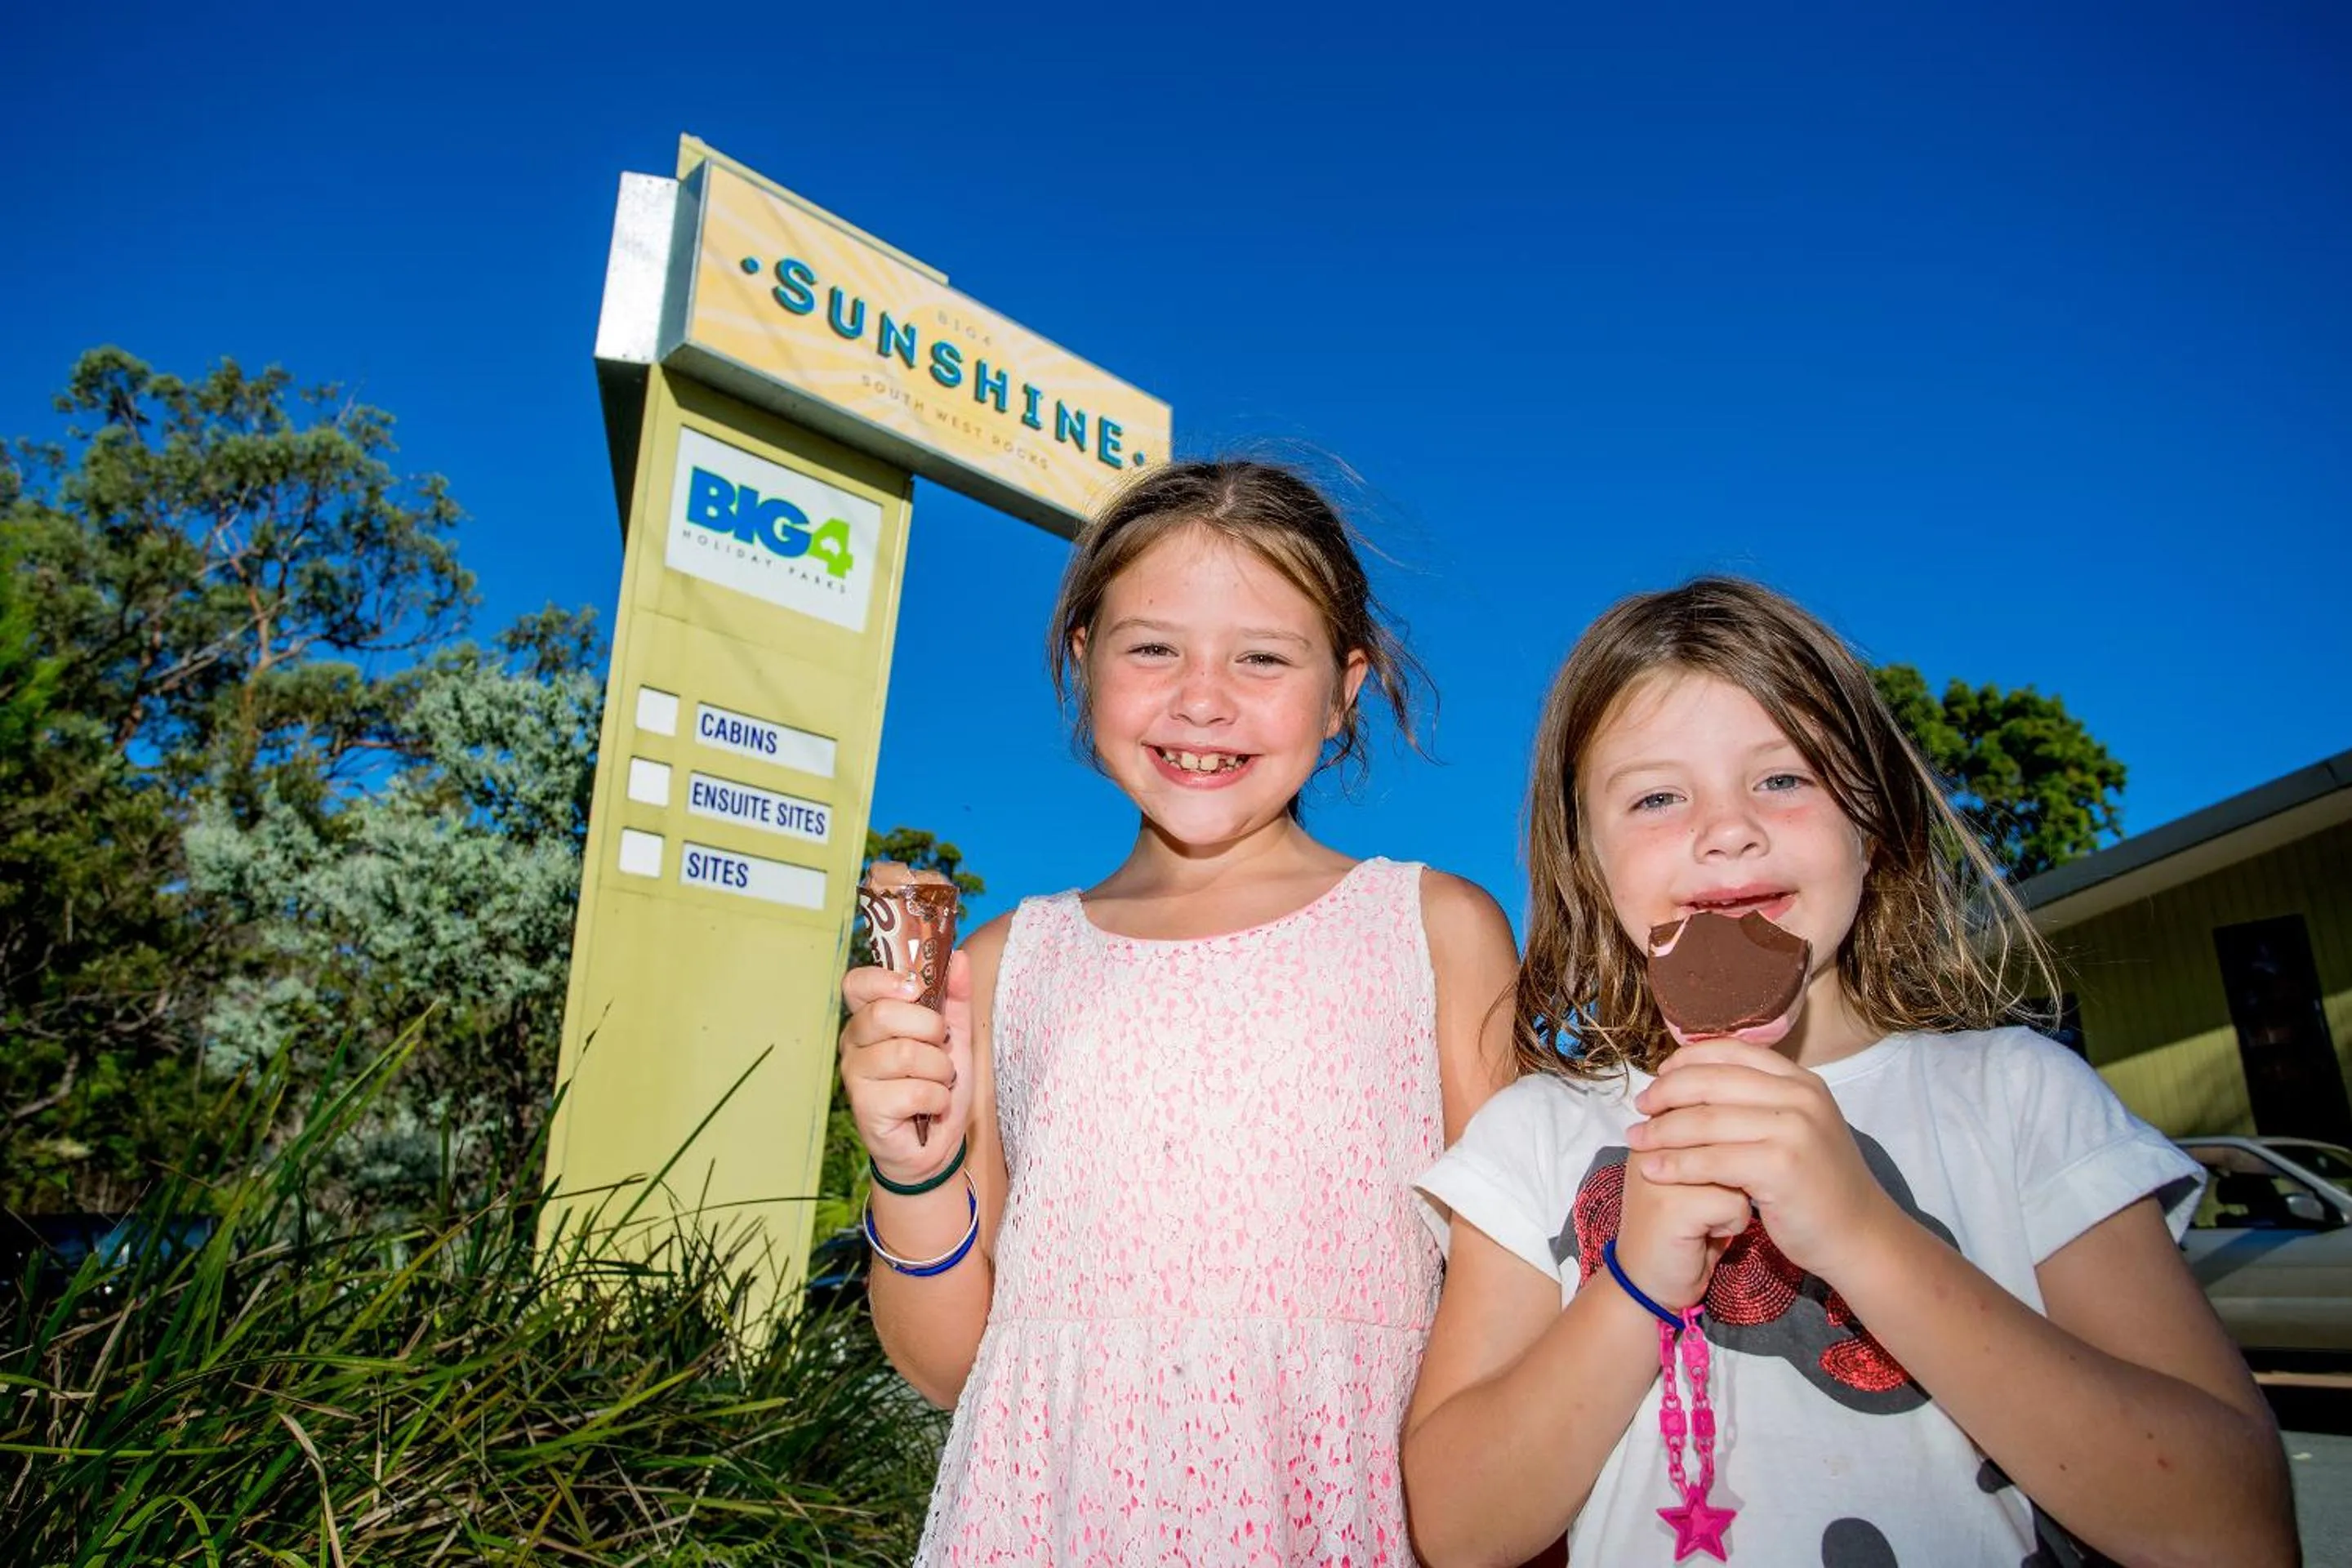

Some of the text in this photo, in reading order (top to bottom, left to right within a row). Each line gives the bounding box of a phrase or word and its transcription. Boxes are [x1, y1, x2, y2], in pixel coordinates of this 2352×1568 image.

[772, 256, 1124, 470] SUNSHINE
[862, 374, 1049, 470] SOUTH WEST ROCKS
[686, 466, 853, 579] BIG4
[682, 529, 846, 594] HOLIDAY PARKS
[701, 713, 778, 755] CABINS
[692, 782, 826, 835] ENSUITE SITES
[687, 853, 749, 889] SITES
